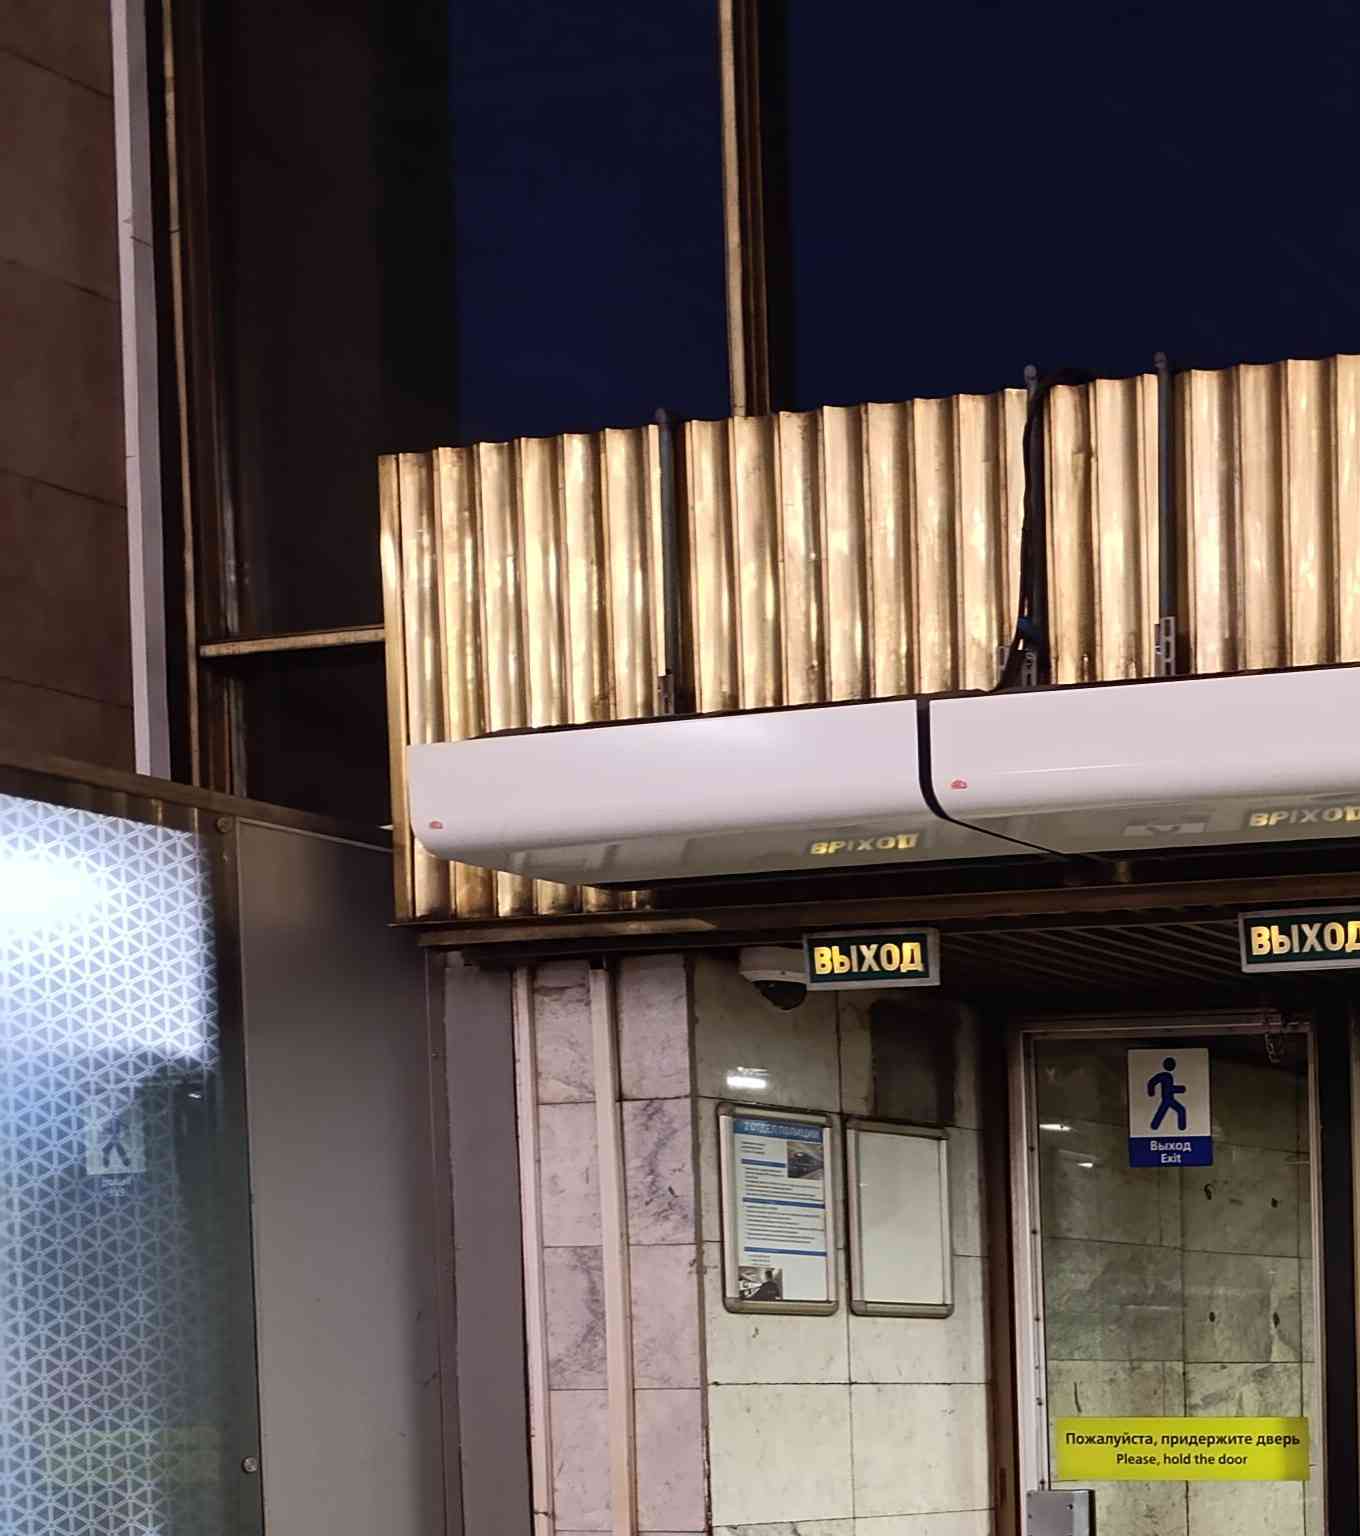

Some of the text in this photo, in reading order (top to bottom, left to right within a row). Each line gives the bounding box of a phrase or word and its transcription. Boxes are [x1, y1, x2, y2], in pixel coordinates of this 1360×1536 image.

[814, 942, 924, 975] ВЫХОД
[1150, 1140, 1192, 1152] Выход
[1160, 1153, 1182, 1164] Exit
[1065, 1432, 1301, 1447] Пожалуйста, придержите дверь
[1116, 1454, 1248, 1466] Please, hold the door
